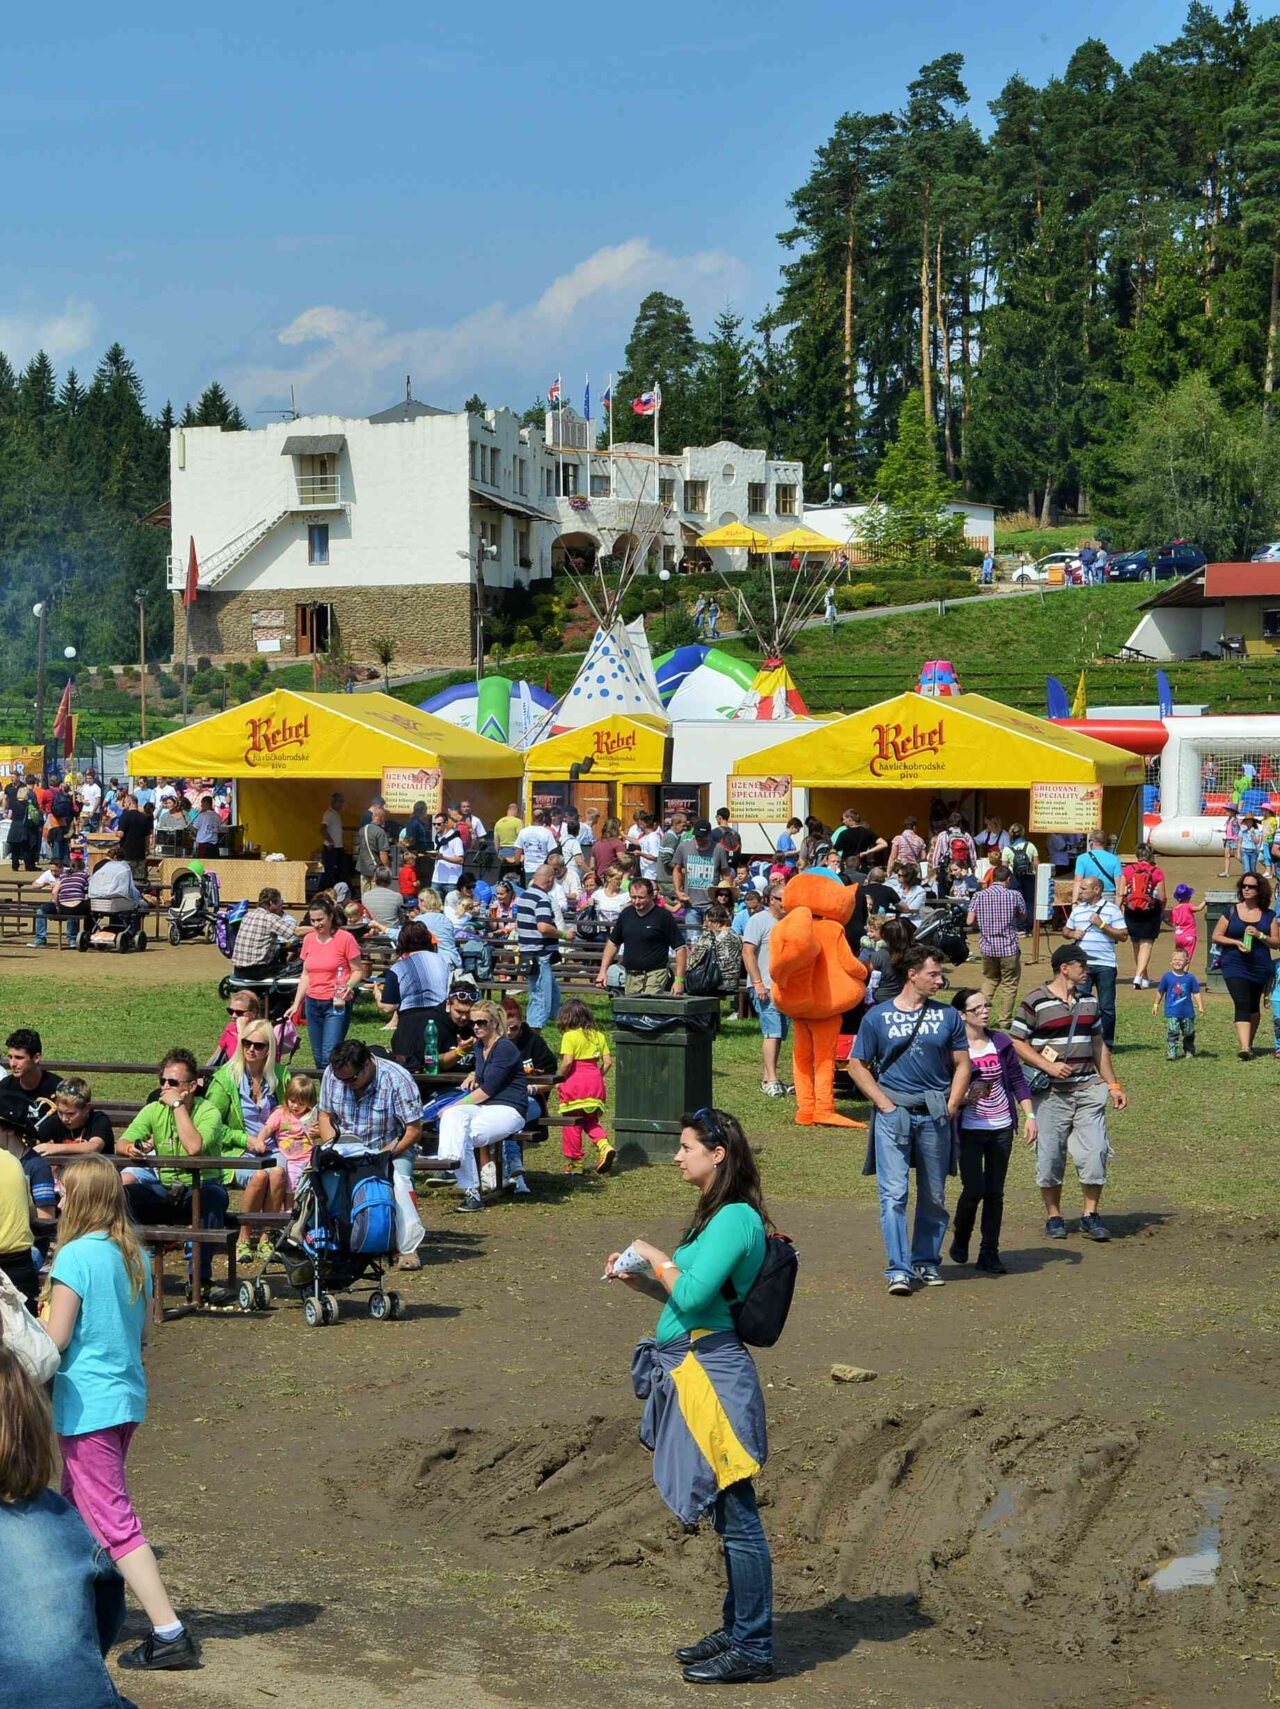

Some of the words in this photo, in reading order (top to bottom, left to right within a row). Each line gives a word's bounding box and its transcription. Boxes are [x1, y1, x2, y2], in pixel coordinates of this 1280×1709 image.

[245, 712, 311, 765] Rebel
[592, 729, 637, 762] Rebel
[870, 719, 946, 777] Rebel
[900, 771, 919, 780] pivo
[731, 791, 782, 799] SPECIALITY
[888, 1022, 941, 1039] ARMY
